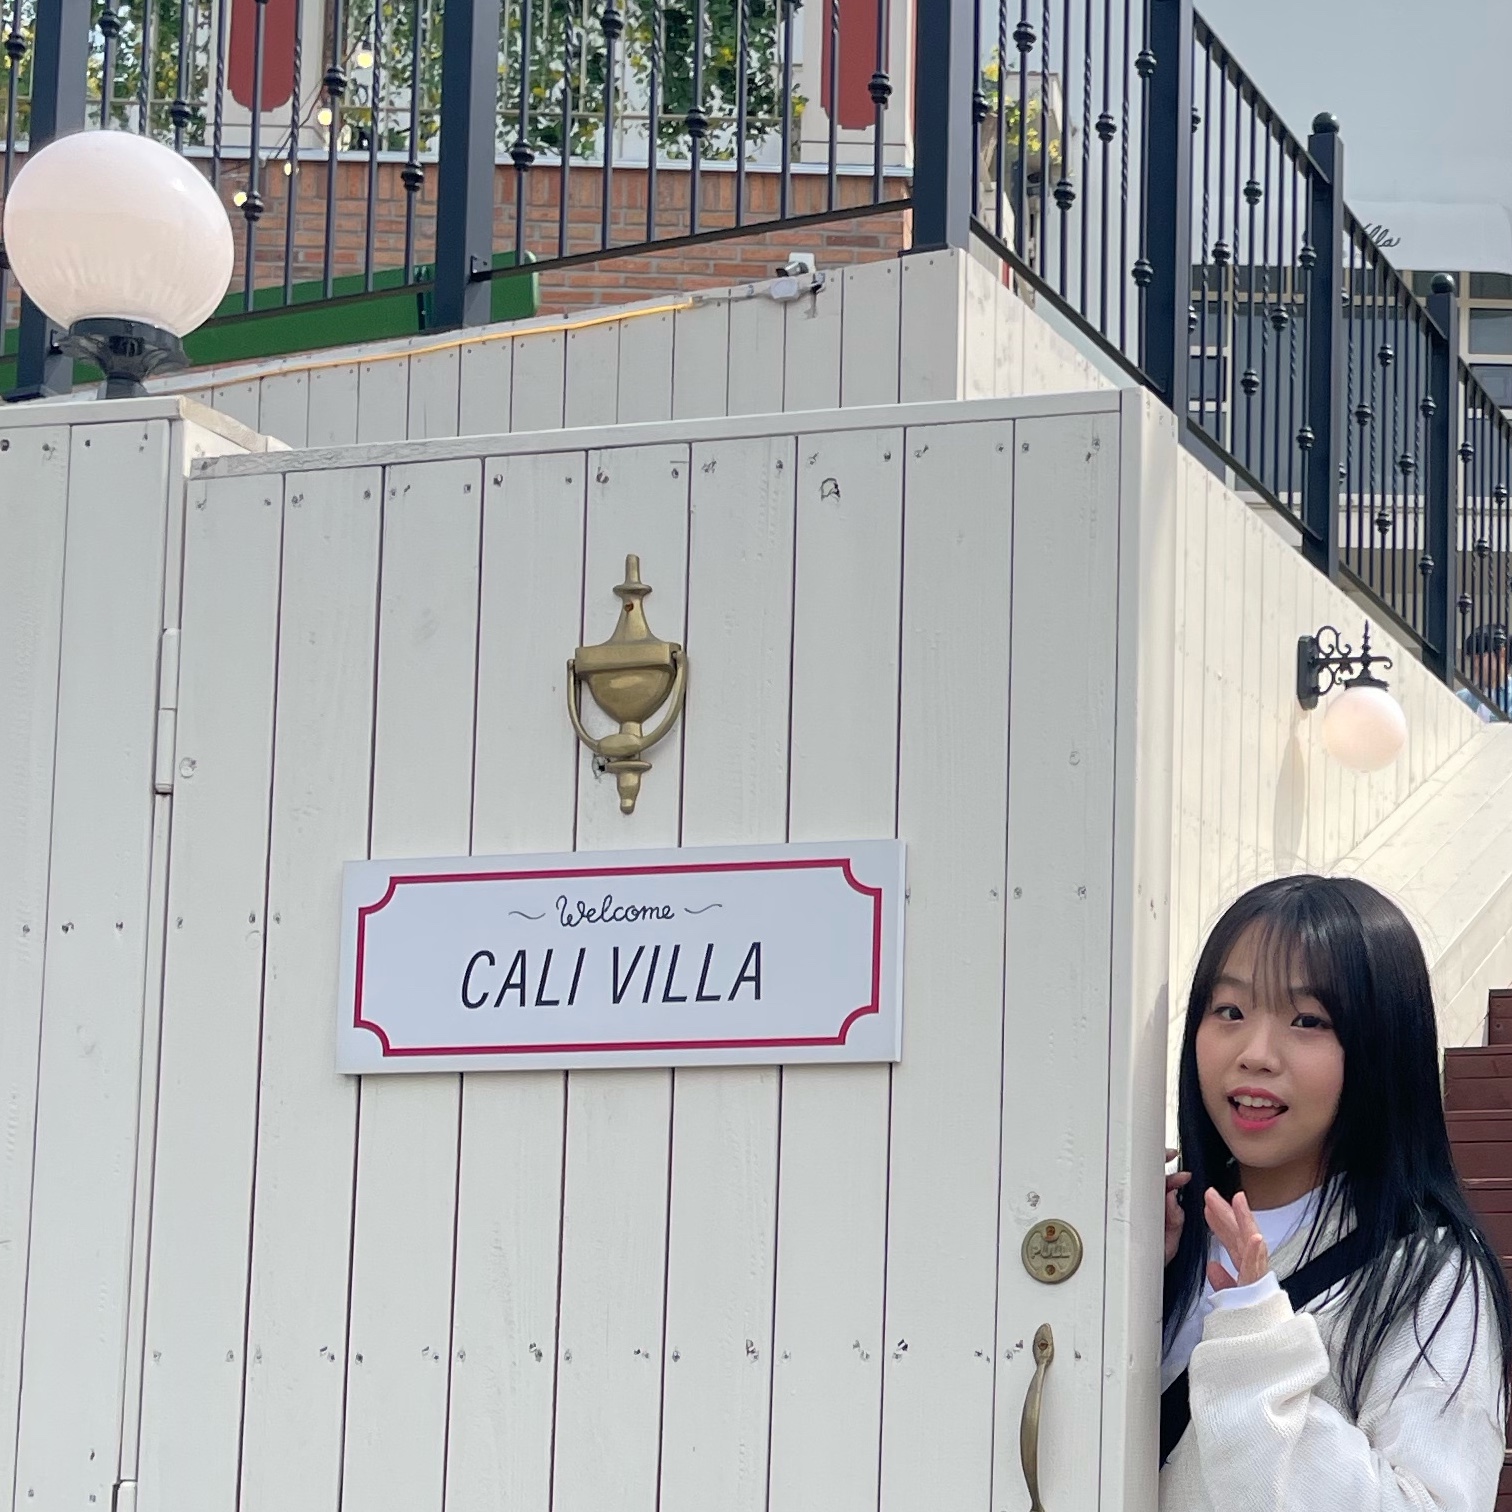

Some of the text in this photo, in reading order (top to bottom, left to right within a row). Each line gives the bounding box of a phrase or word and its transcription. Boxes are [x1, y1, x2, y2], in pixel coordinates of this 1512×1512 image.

[556, 895, 675, 928] Welcome
[460, 941, 762, 1009] CALI VILLA
[1030, 1242, 1071, 1260] PULL
